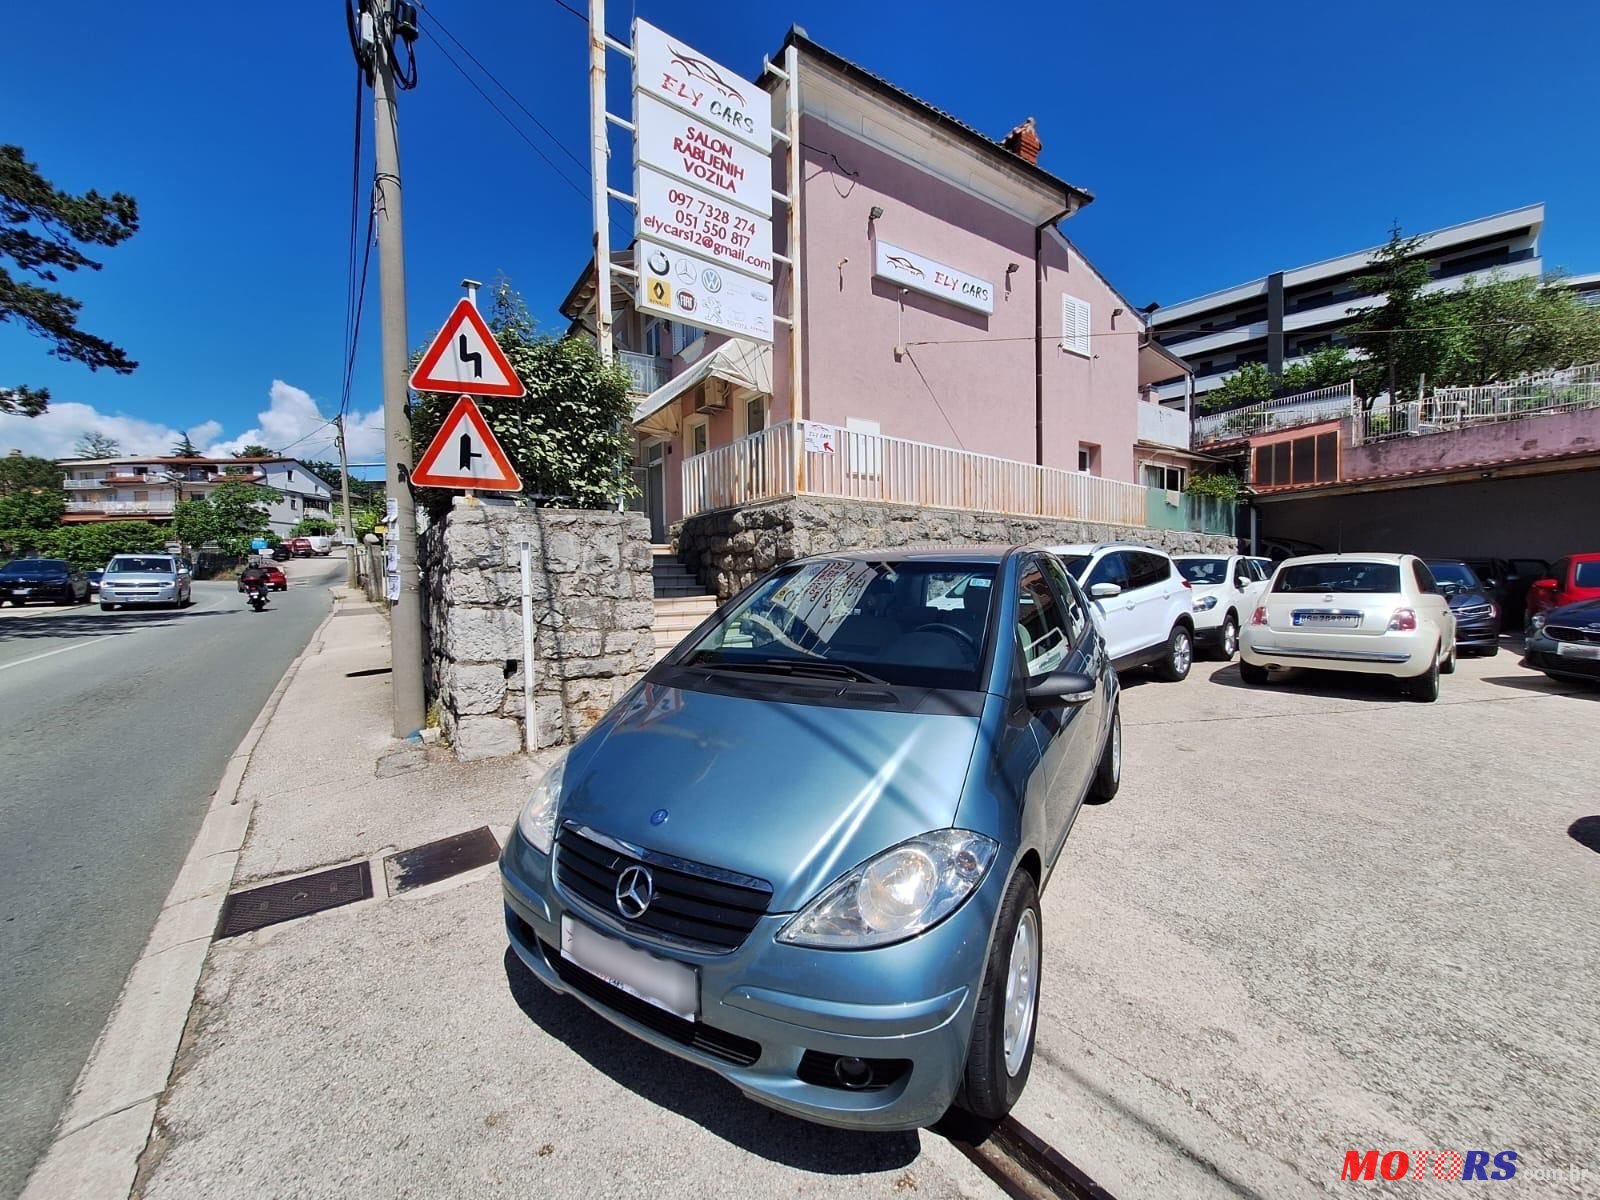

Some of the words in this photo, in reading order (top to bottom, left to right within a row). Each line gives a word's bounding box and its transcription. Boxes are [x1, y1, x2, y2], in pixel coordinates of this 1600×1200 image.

[661, 72, 704, 107] ELY
[709, 101, 754, 133] CARS
[673, 136, 745, 181] RABLJENIH
[686, 126, 733, 159] SALON
[683, 158, 737, 193] VOZILA
[668, 189, 694, 209] 097
[698, 200, 730, 225] 7328
[734, 217, 756, 236] 274
[675, 210, 698, 230] 051
[702, 220, 727, 240] 550
[730, 233, 750, 249] 817
[643, 215, 771, 272] elycars12@gmail.com
[934, 271, 959, 291] ELY
[962, 282, 989, 302] CARS
